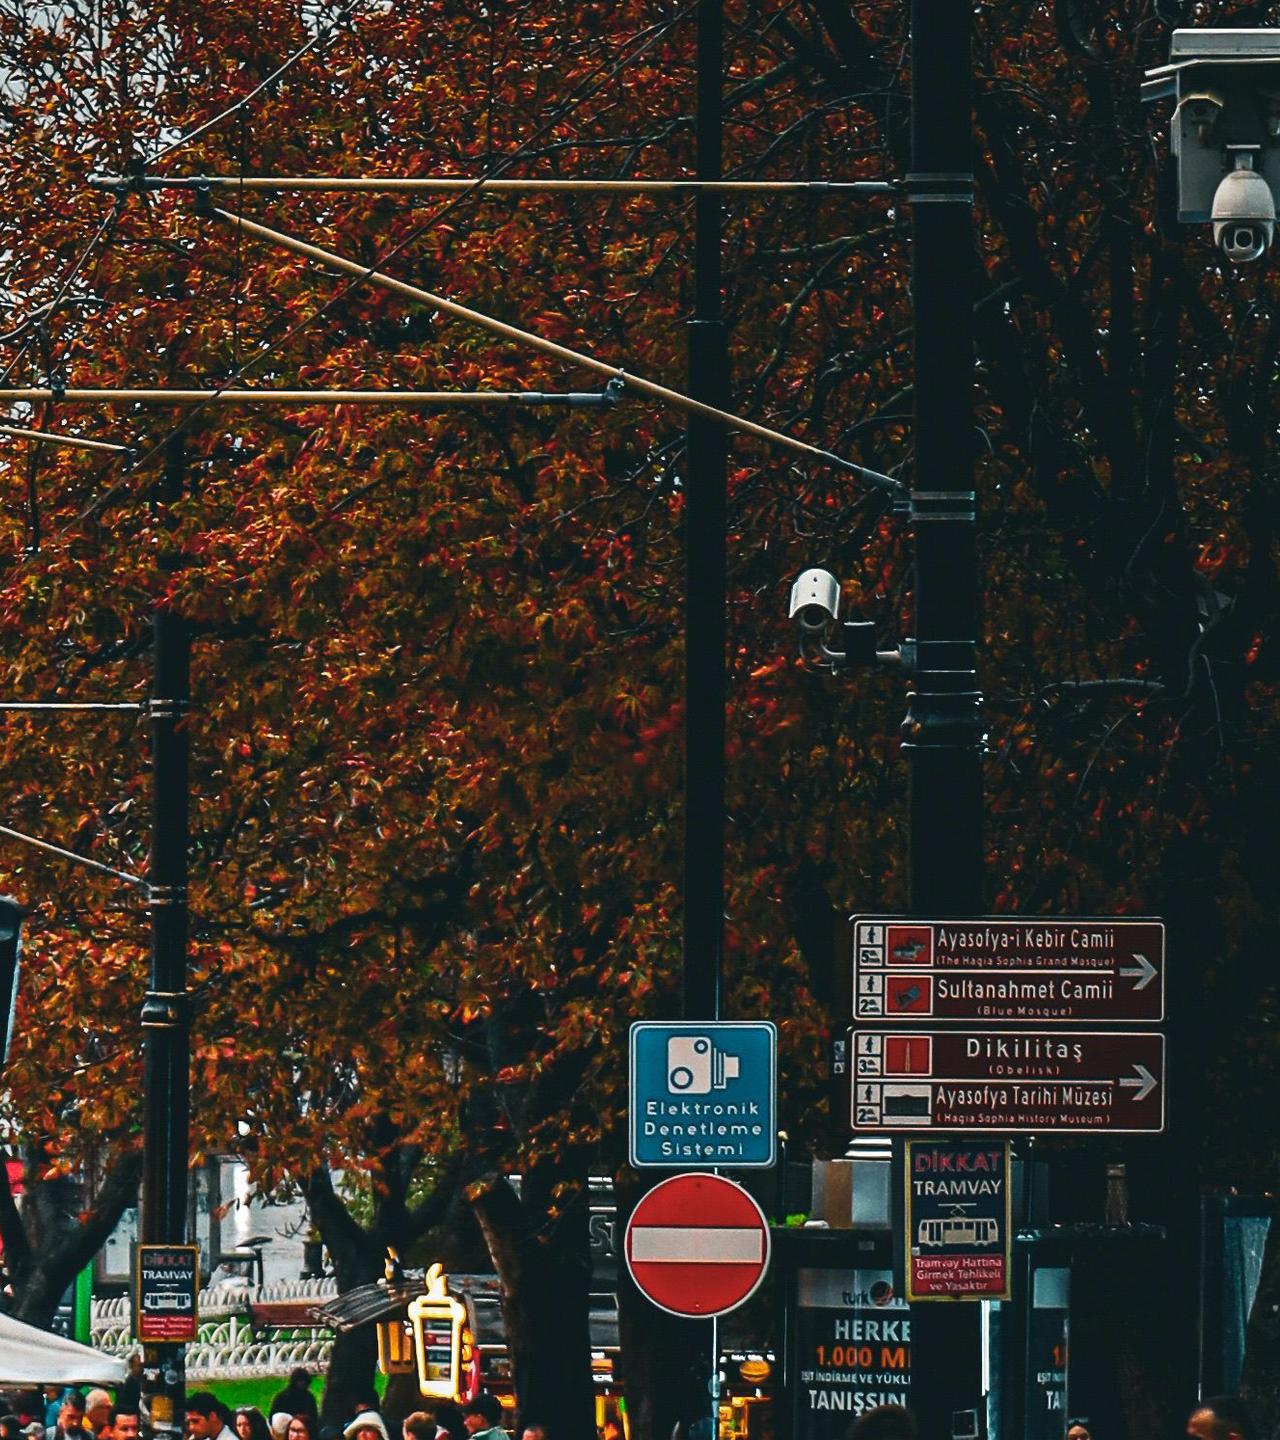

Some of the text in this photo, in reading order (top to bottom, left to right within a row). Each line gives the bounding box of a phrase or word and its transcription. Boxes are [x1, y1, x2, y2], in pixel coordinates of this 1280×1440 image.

[938, 928, 1114, 952] Ayasofya-i Kebir Camii
[996, 956, 1033, 967] Sophia
[938, 980, 1114, 1000] Sultanahmet Camii
[966, 1037, 1083, 1063] Dikilitaş
[936, 1085, 1113, 1110] Ayasofya Tarihi Müzesi
[646, 1101, 759, 1116] Elektronik
[978, 1113, 1015, 1125] Sophia
[1018, 1113, 1056, 1125] History
[644, 1122, 762, 1136] Denetleme
[661, 1141, 743, 1155] Sistemi
[914, 1149, 1002, 1173] DİKKAT
[913, 1179, 1002, 1196] TRAMVAY
[916, 1258, 960, 1269] Tramvay
[142, 1270, 193, 1280] TRAMVAY
[916, 1270, 954, 1280] Girmek
[815, 1345, 873, 1367] 1.000
[859, 1373, 873, 1384] VE
[875, 1372, 911, 1385] YÜKL
